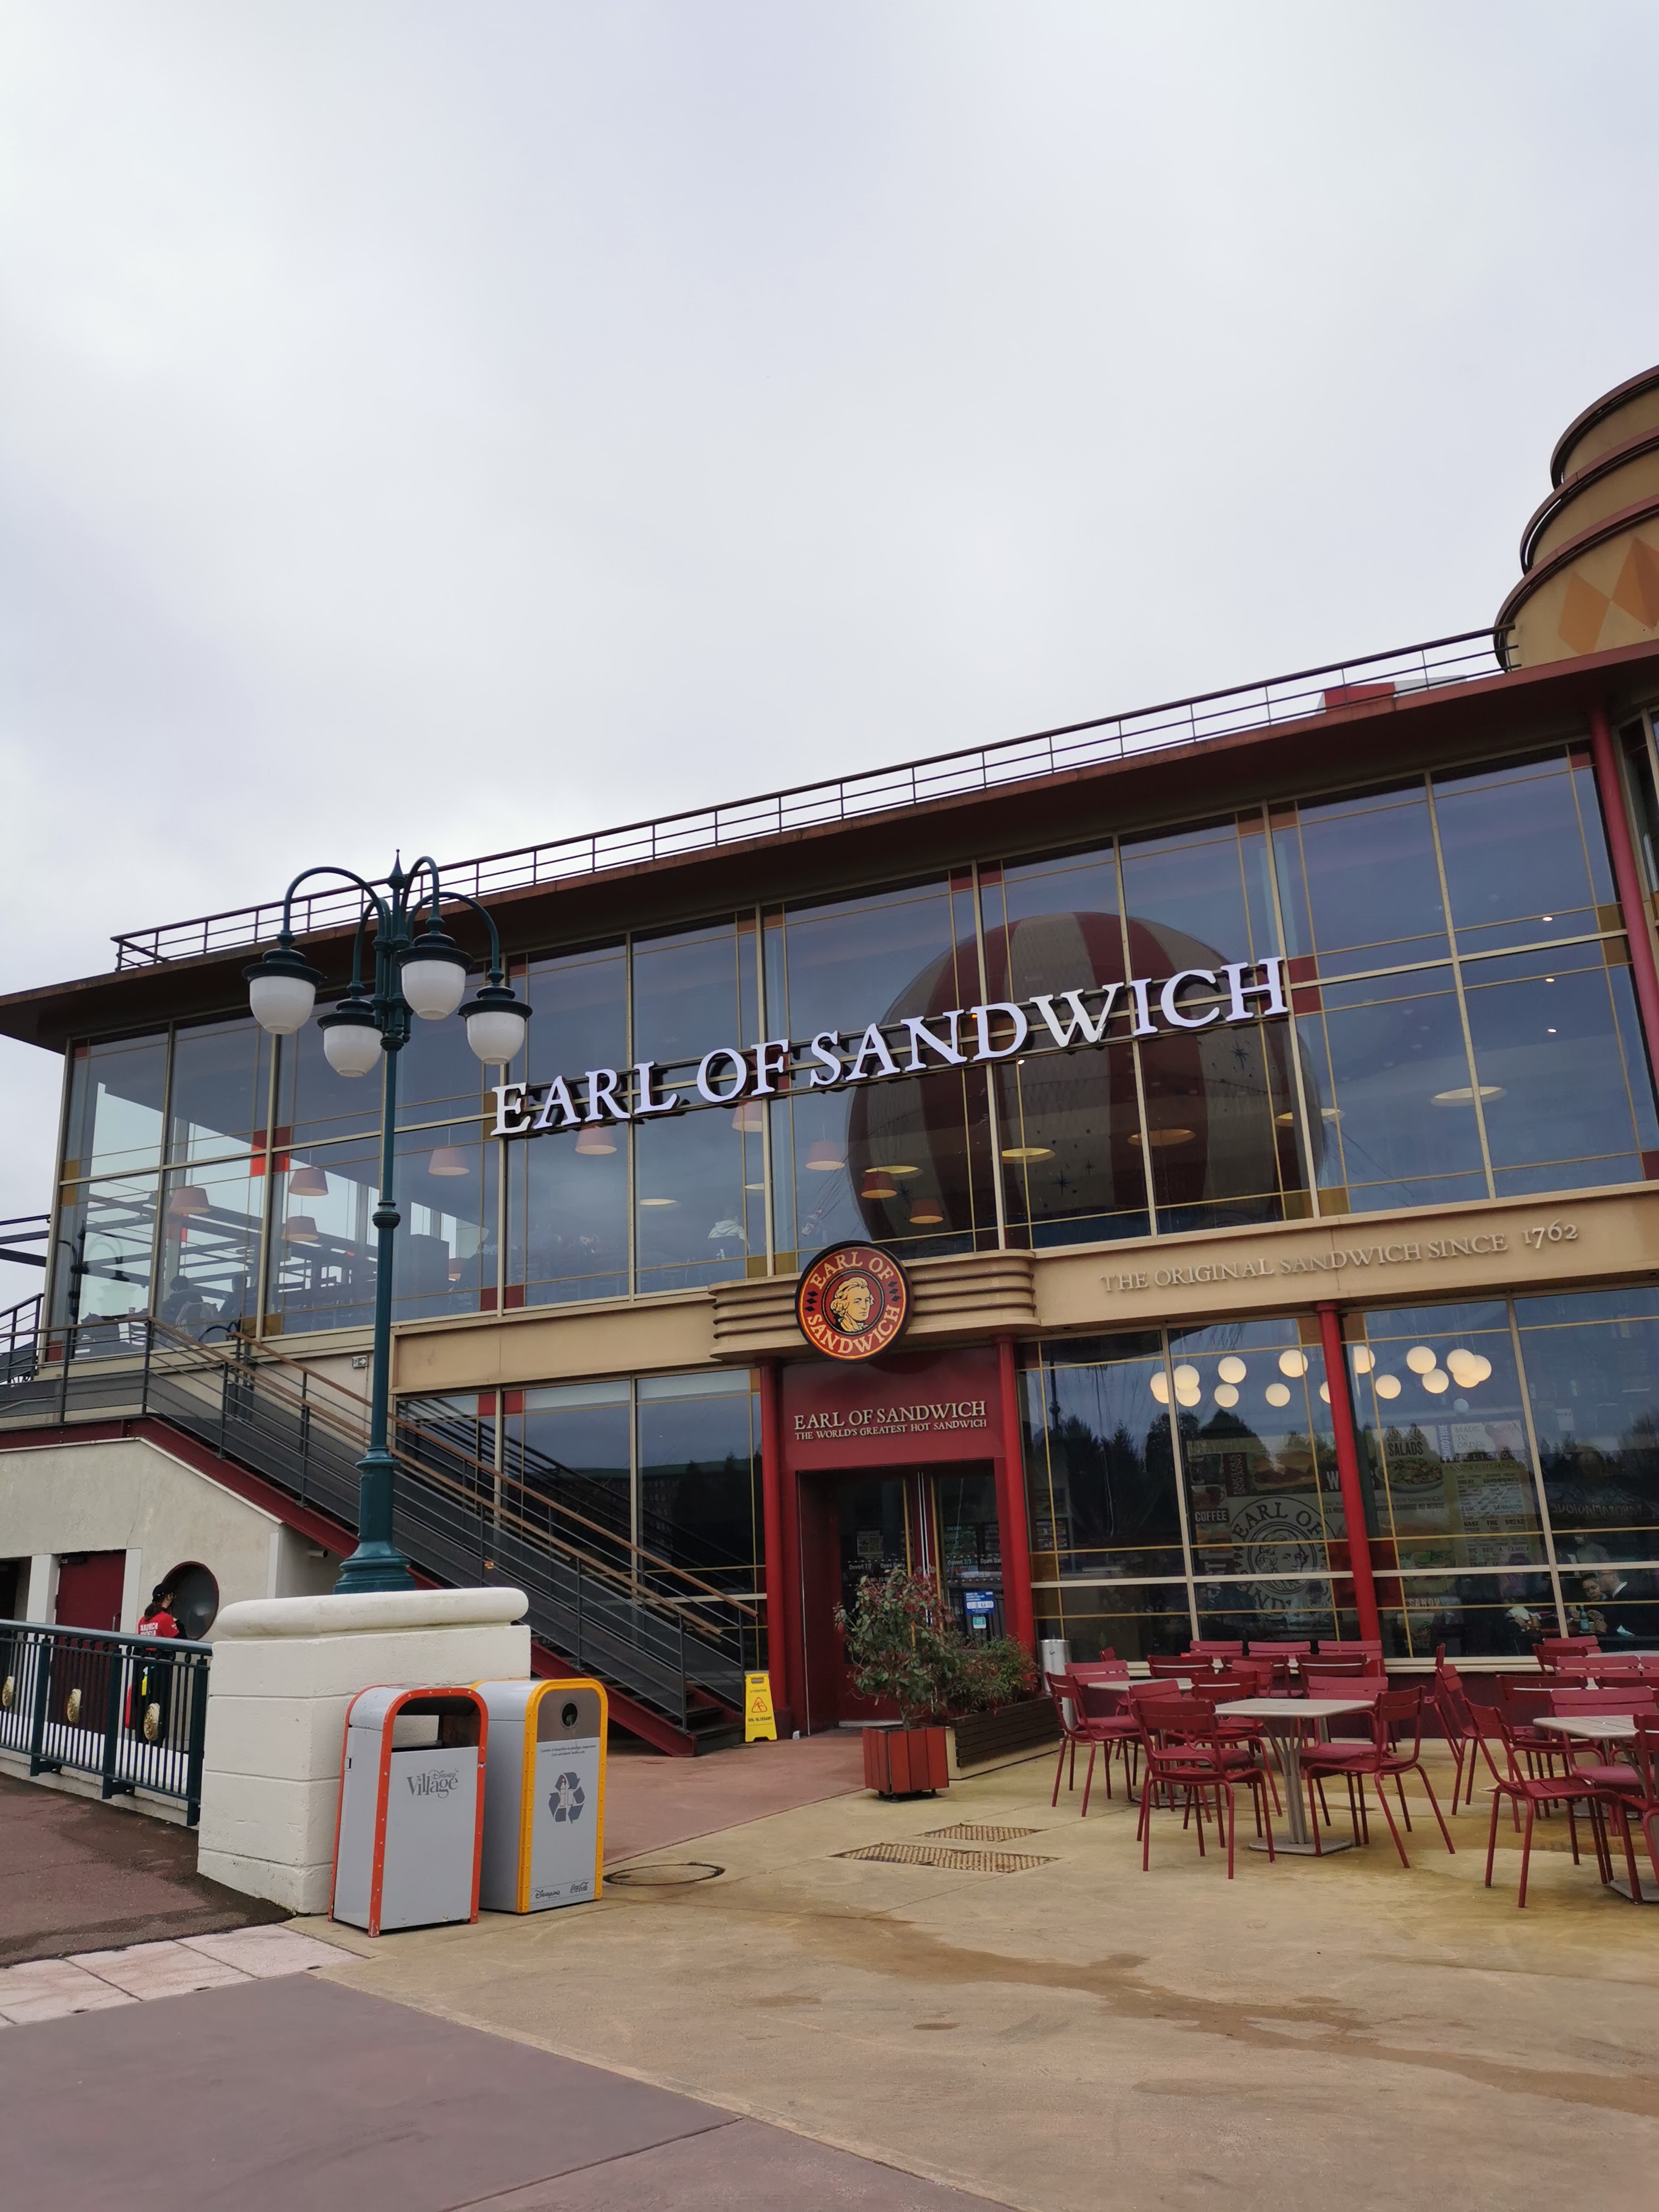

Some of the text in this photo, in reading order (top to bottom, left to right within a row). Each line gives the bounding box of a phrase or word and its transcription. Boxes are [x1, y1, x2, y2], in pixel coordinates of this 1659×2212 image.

[490, 957, 1289, 1136] EARL OF SANDWICH
[810, 1252, 894, 1290] EARL OF
[1100, 1219, 1578, 1292] THE ORIGINAL SANDWICH SINCE 1762
[807, 1304, 900, 1354] SANDWICH
[794, 1401, 986, 1430] EARL OF SANDWICH
[795, 1419, 987, 1441] THE WORLD'S GREATEST HOT SANDWICH
[1388, 1441, 1424, 1456] SALADS
[1195, 1510, 1228, 1523] COFFEE
[1232, 1501, 1324, 1539] EARL OF
[406, 1773, 458, 1799] Village
